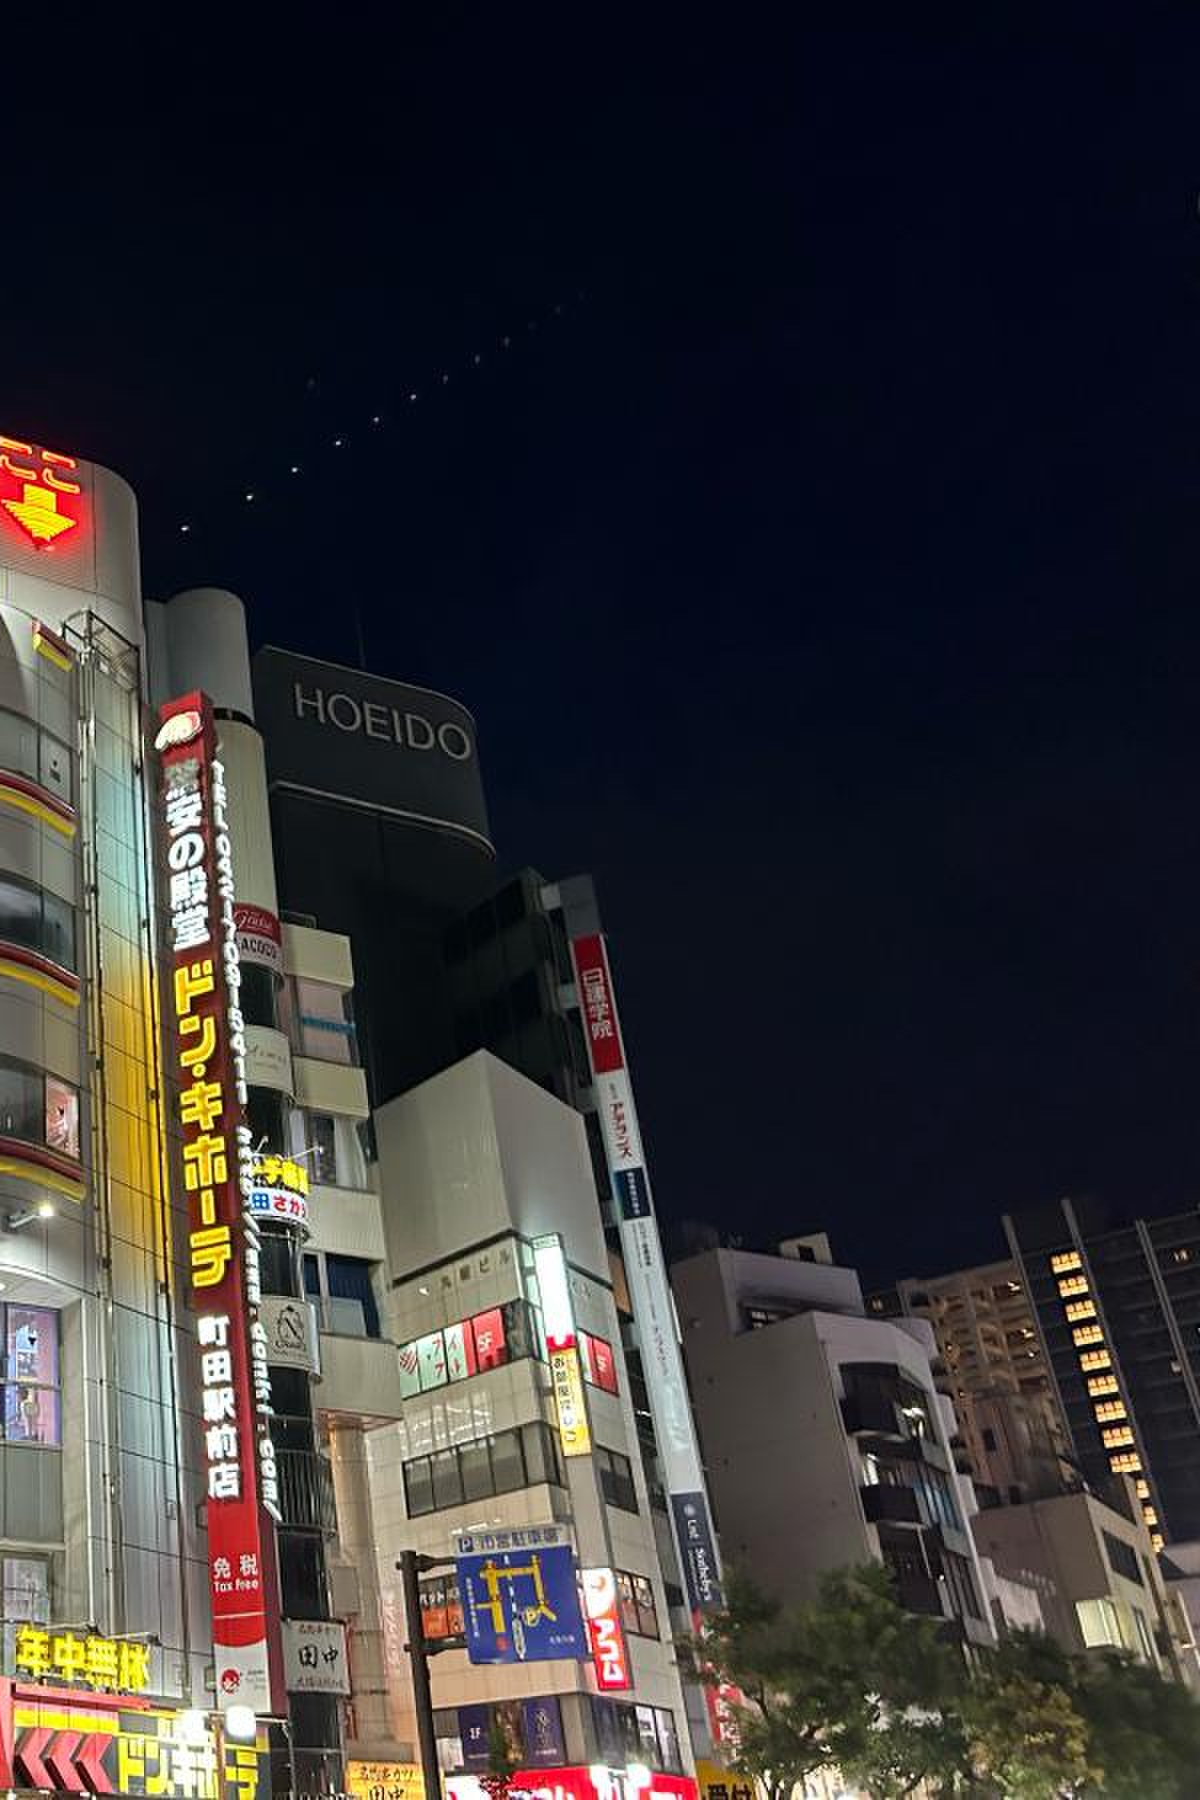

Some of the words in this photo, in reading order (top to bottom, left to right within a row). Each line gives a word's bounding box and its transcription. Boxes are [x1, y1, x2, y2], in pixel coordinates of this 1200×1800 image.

[294, 682, 471, 760] HOEIDO
[174, 958, 232, 1288] ドン・キホーテ
[196, 1314, 242, 1501] 町田駅前店
[213, 1553, 258, 1579] 免税
[213, 1580, 233, 1593] Tax
[593, 1619, 625, 1681] アコム
